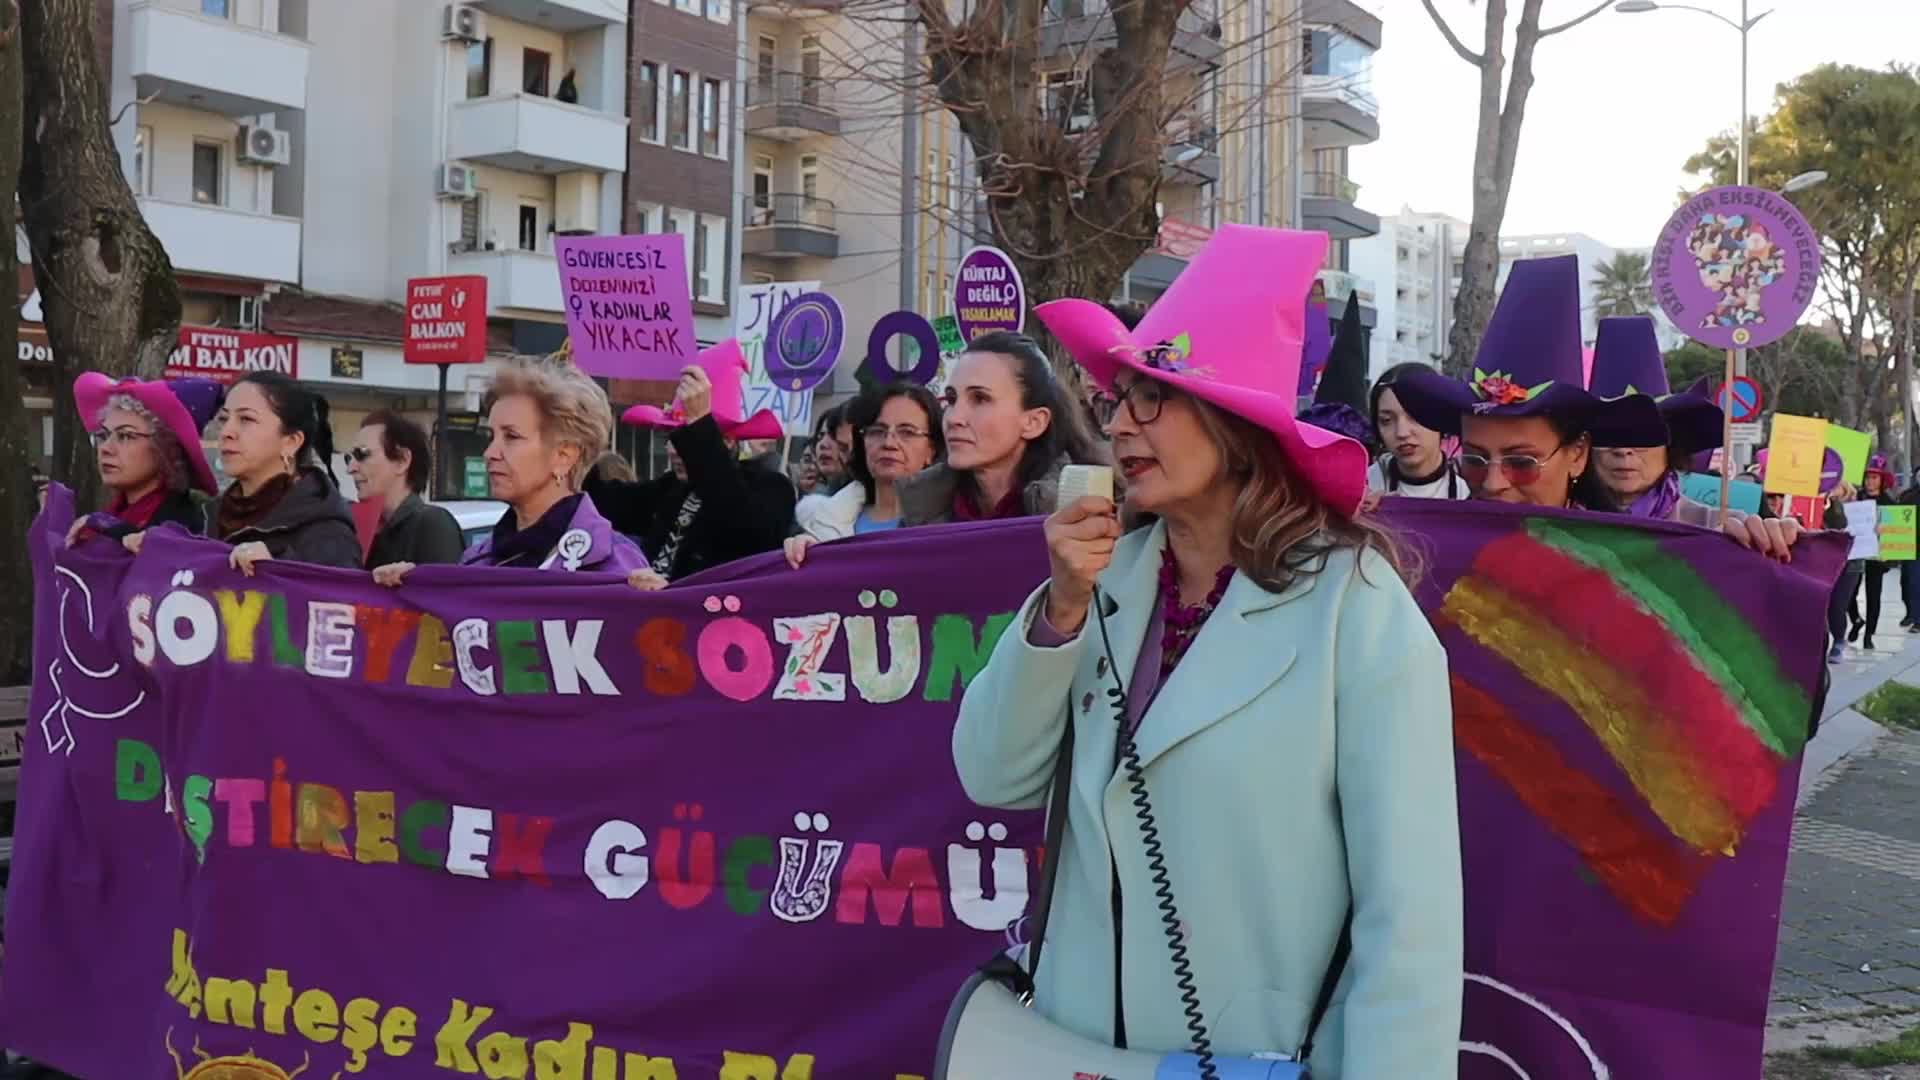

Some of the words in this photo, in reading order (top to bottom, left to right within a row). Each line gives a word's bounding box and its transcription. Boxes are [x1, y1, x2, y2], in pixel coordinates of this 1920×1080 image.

[962, 264, 1007, 282] KÜRTAJ
[967, 283, 1002, 303] DEĞİL
[411, 303, 443, 320] CAM
[590, 299, 673, 322] KADINLAR
[410, 321, 465, 339] BALKON
[582, 320, 685, 357] YIKACAK
[195, 343, 293, 374] BALKON
[127, 569, 622, 697] SÖYLEYECEK
[584, 802, 1047, 931] GÜCÜMÜ
